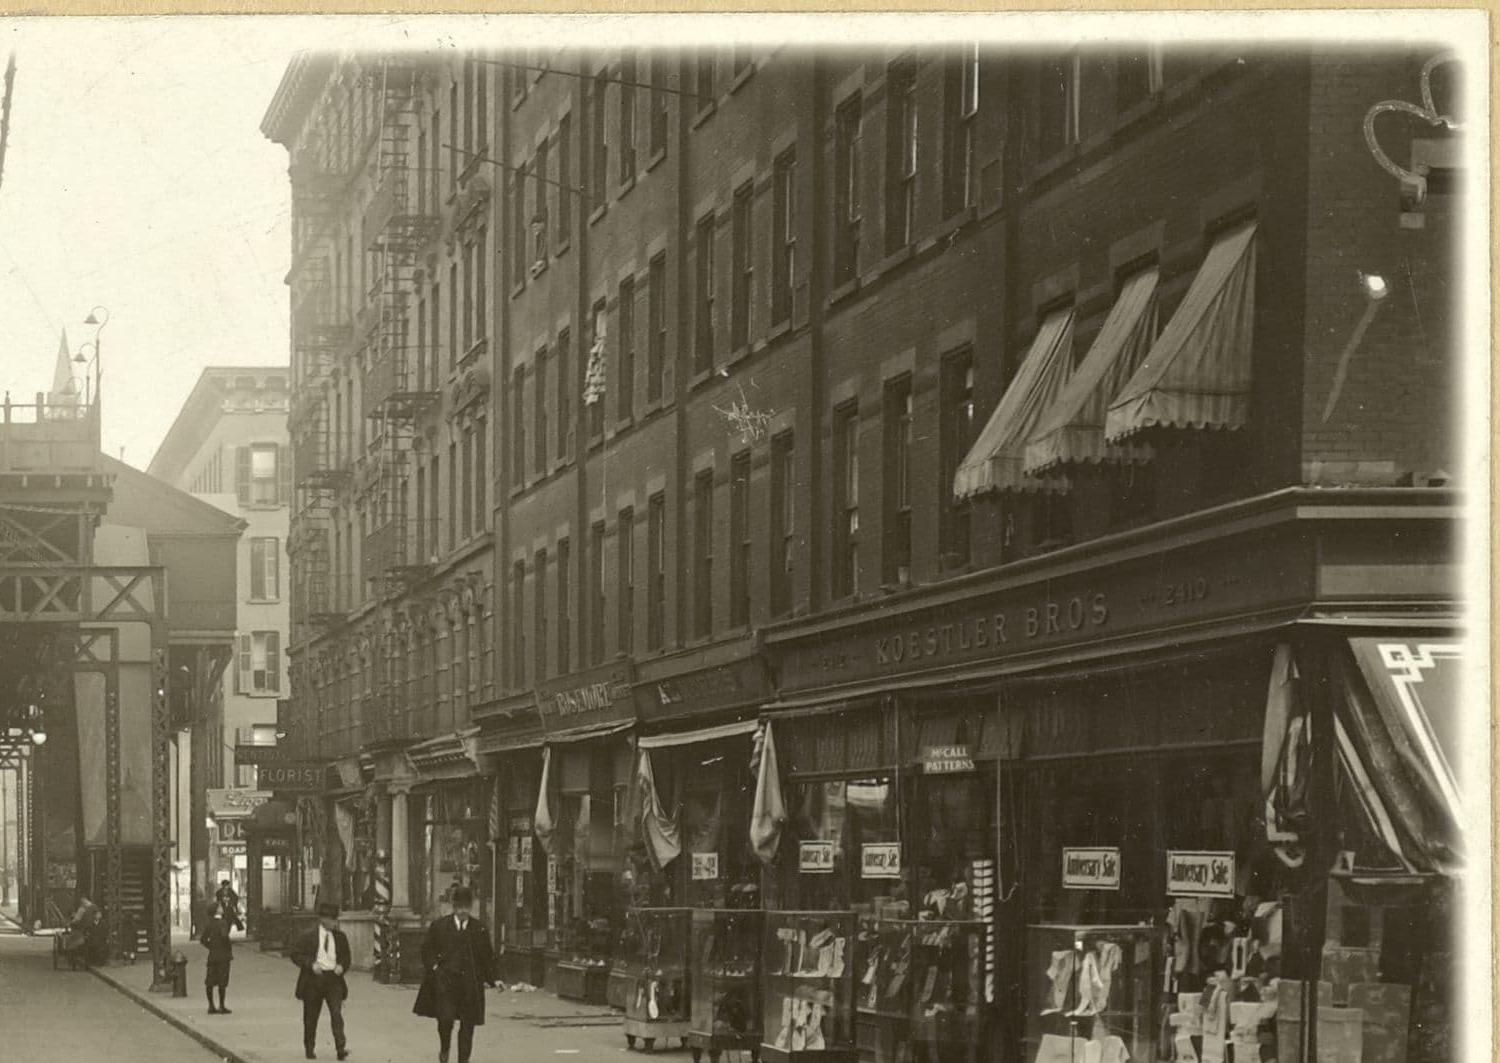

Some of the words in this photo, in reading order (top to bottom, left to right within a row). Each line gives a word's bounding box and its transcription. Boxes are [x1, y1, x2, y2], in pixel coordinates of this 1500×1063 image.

[874, 612, 1008, 665] KOESTLER
[260, 768, 320, 783] FLORIST
[925, 760, 975, 771] PATTERNS
[1211, 859, 1229, 885] Sale
